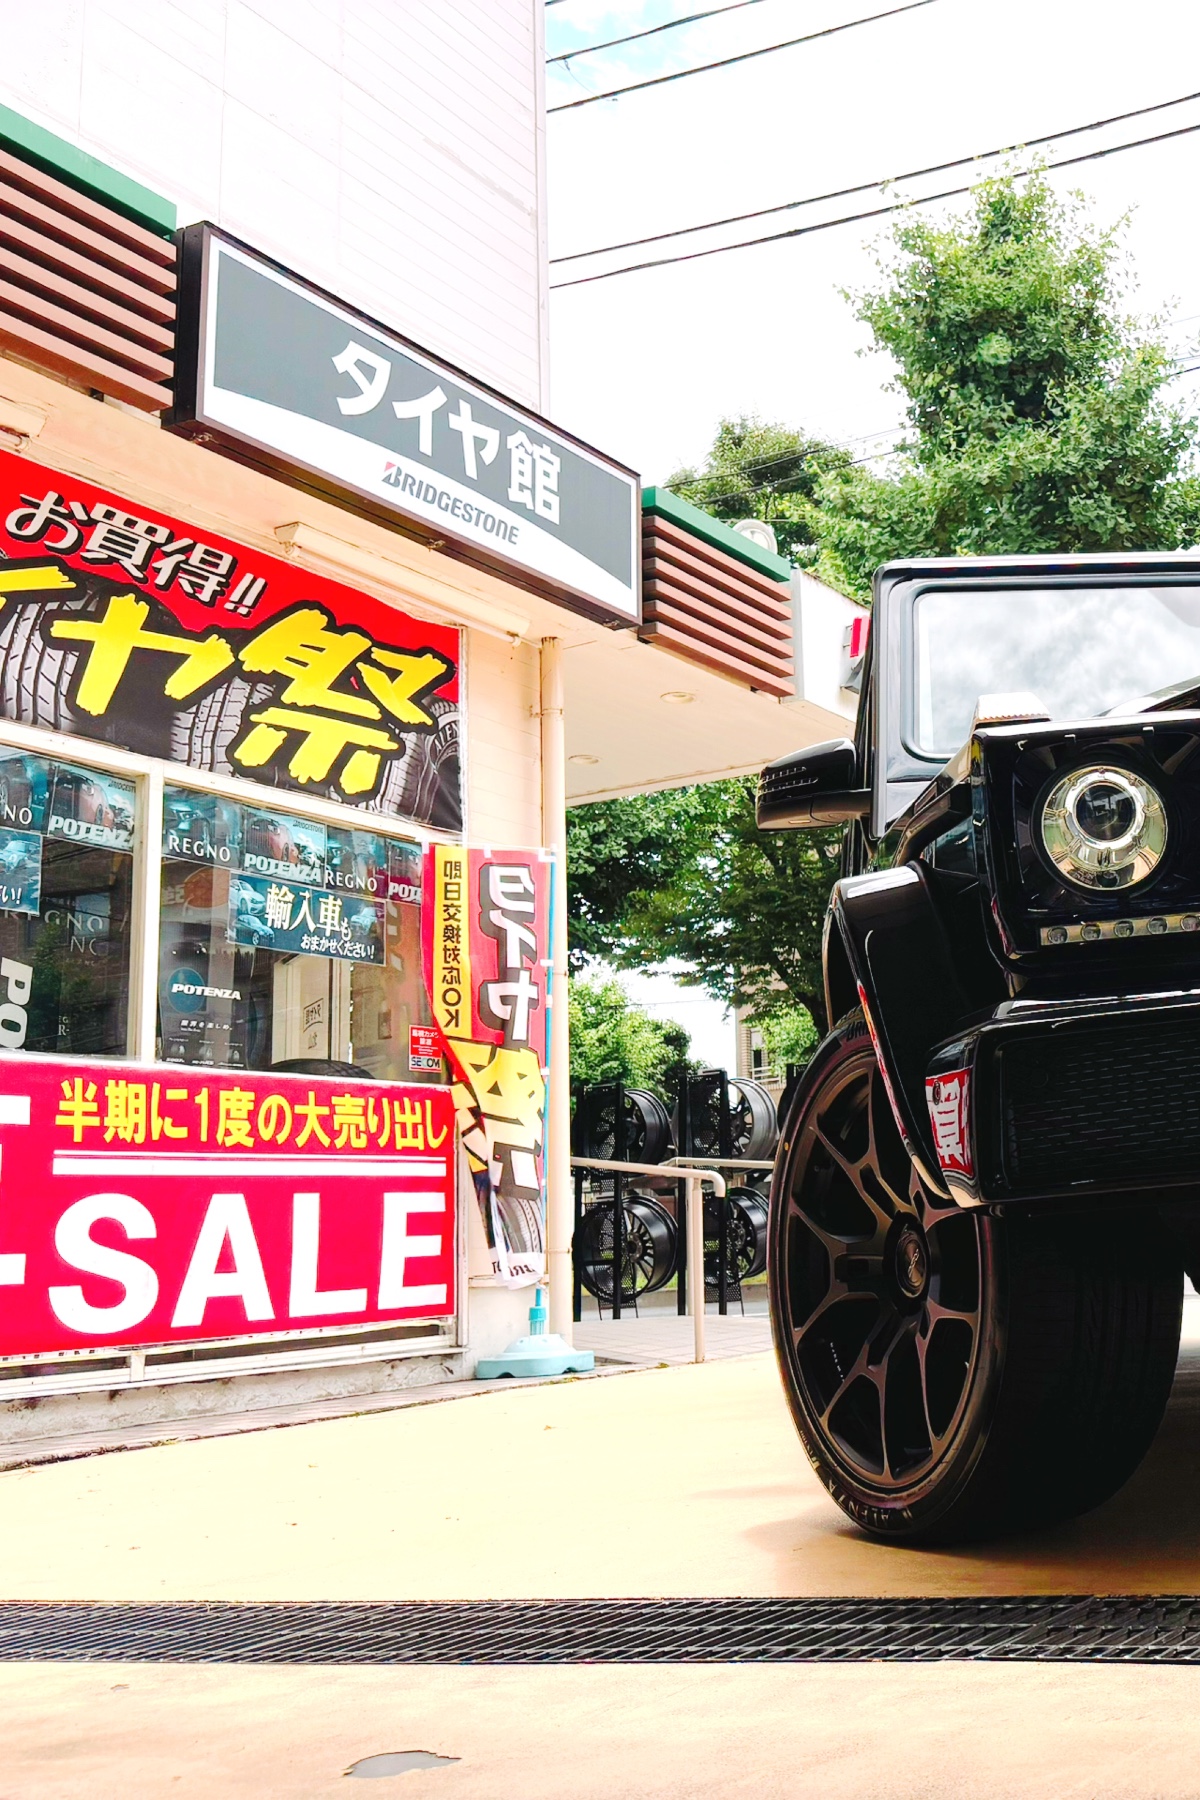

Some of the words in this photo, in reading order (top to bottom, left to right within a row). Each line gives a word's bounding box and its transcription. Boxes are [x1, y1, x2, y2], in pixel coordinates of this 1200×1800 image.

[331, 340, 562, 524] タイヤ館
[382, 461, 519, 545] BRIDGESTONE
[0, 565, 447, 796] ヤ祭
[168, 834, 231, 863] REGNO
[244, 852, 323, 884] POTENZA
[325, 870, 378, 892] REGNO
[264, 883, 353, 942] 輸入車も
[171, 983, 242, 1000] POTENZA
[411, 1056, 441, 1068] SECOM
[55, 1077, 448, 1150] 半期に1度の大売り出し
[48, 1192, 448, 1334] SALE
